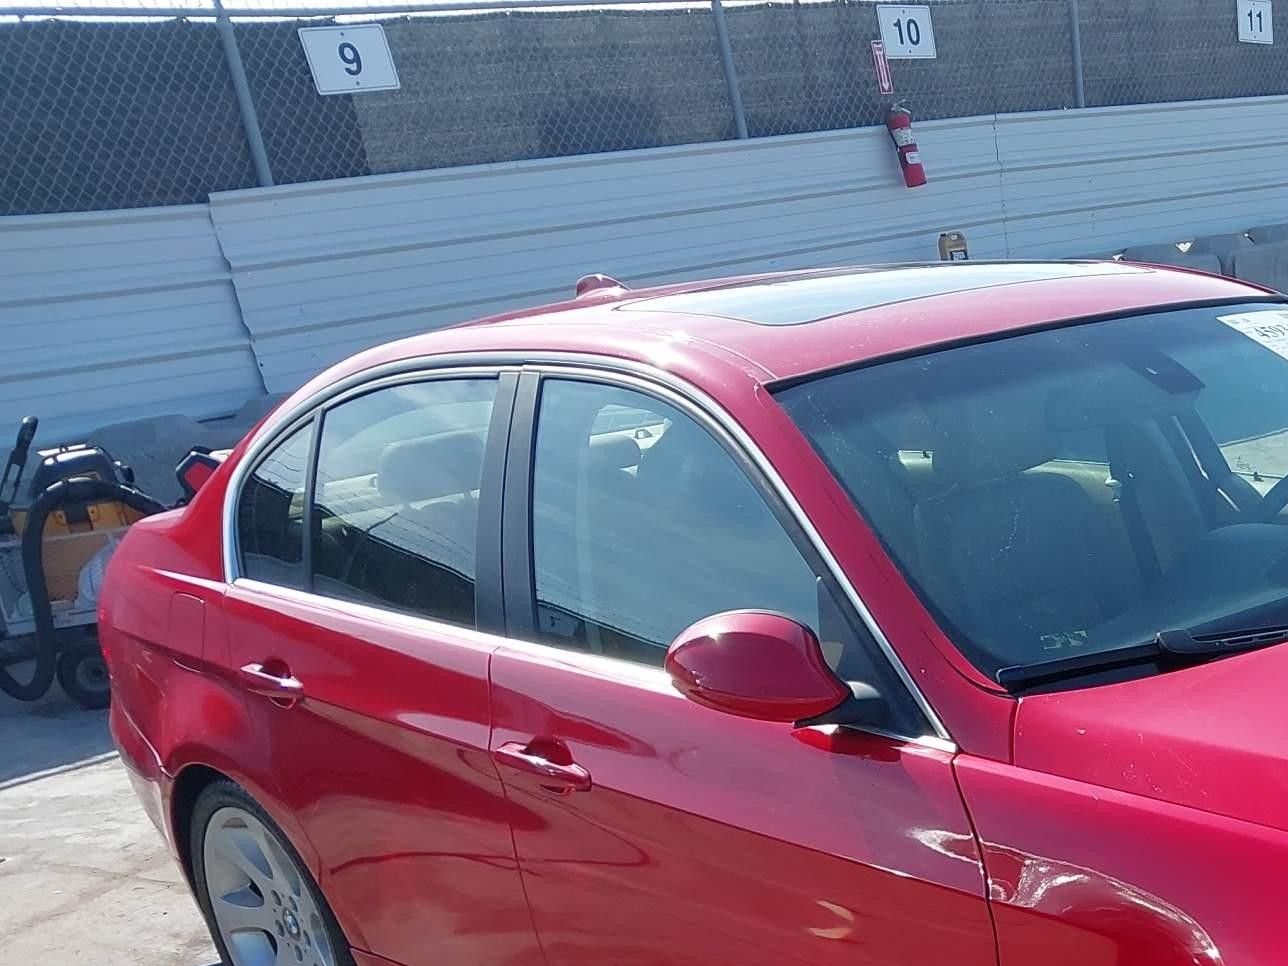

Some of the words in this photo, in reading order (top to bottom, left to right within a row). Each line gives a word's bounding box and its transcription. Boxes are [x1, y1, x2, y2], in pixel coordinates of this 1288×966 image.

[892, 18, 920, 46] 10
[1247, 9, 1263, 33] 11
[338, 42, 362, 76] 9
